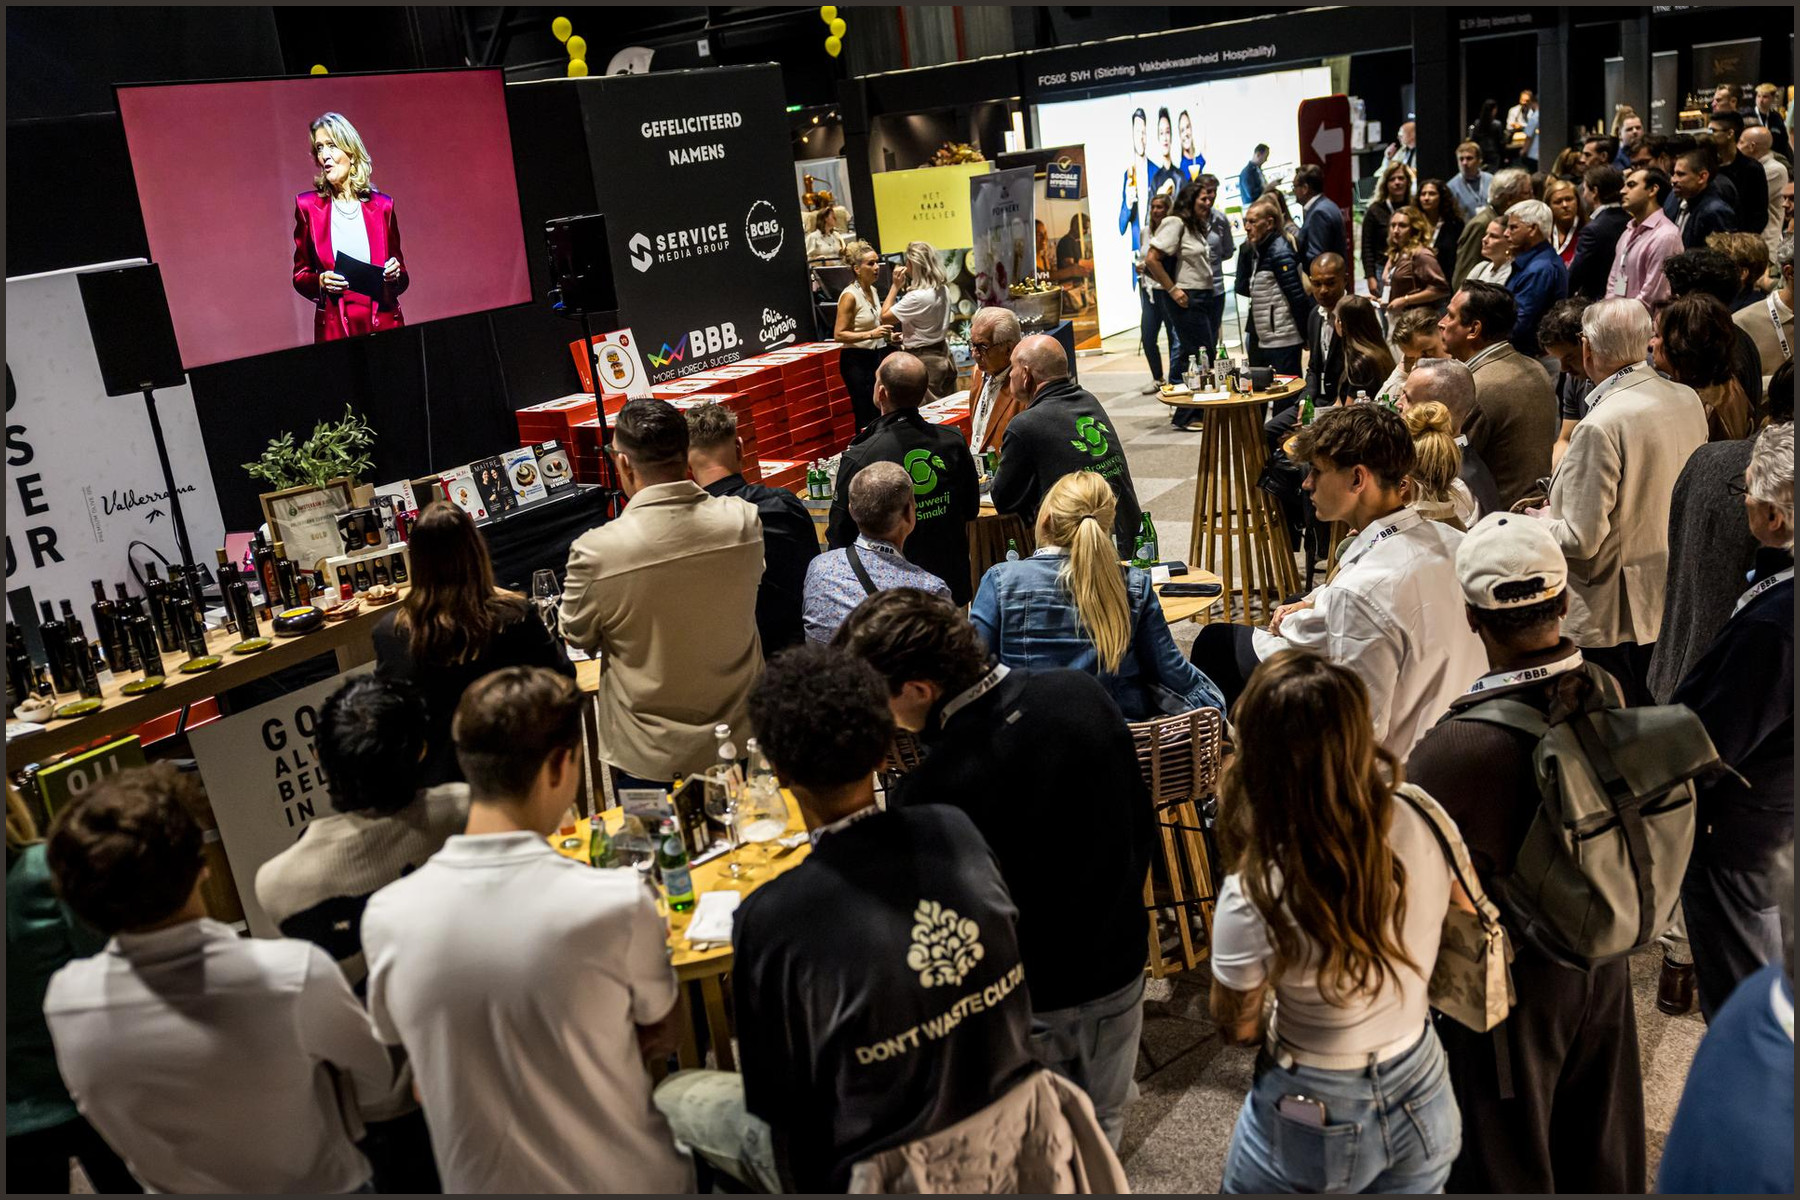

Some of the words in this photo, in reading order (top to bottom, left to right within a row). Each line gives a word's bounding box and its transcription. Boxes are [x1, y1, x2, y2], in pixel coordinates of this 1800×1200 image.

[1038, 73, 1067, 86] FC502
[1070, 69, 1091, 82] SVH
[1094, 64, 1136, 80] (Stichting
[1139, 52, 1219, 72] Vakbekwaamheid
[1222, 44, 1277, 61] Hospitality)
[641, 112, 742, 138] GEFELICITEERD
[669, 144, 725, 166] NAMENS
[656, 222, 729, 251] SERVICE
[750, 219, 779, 237] BCBG
[658, 249, 692, 263] MEDIA
[697, 240, 730, 255] GROUP
[1036, 271, 1050, 279] VH
[653, 369, 676, 383] MORE
[678, 361, 709, 376] HORECA
[710, 352, 741, 367] SUCCESS
[917, 505, 947, 521] Smakt
[285, 798, 315, 827] IN
[855, 1026, 921, 1065] DON'T
[920, 992, 985, 1040] WASTE
